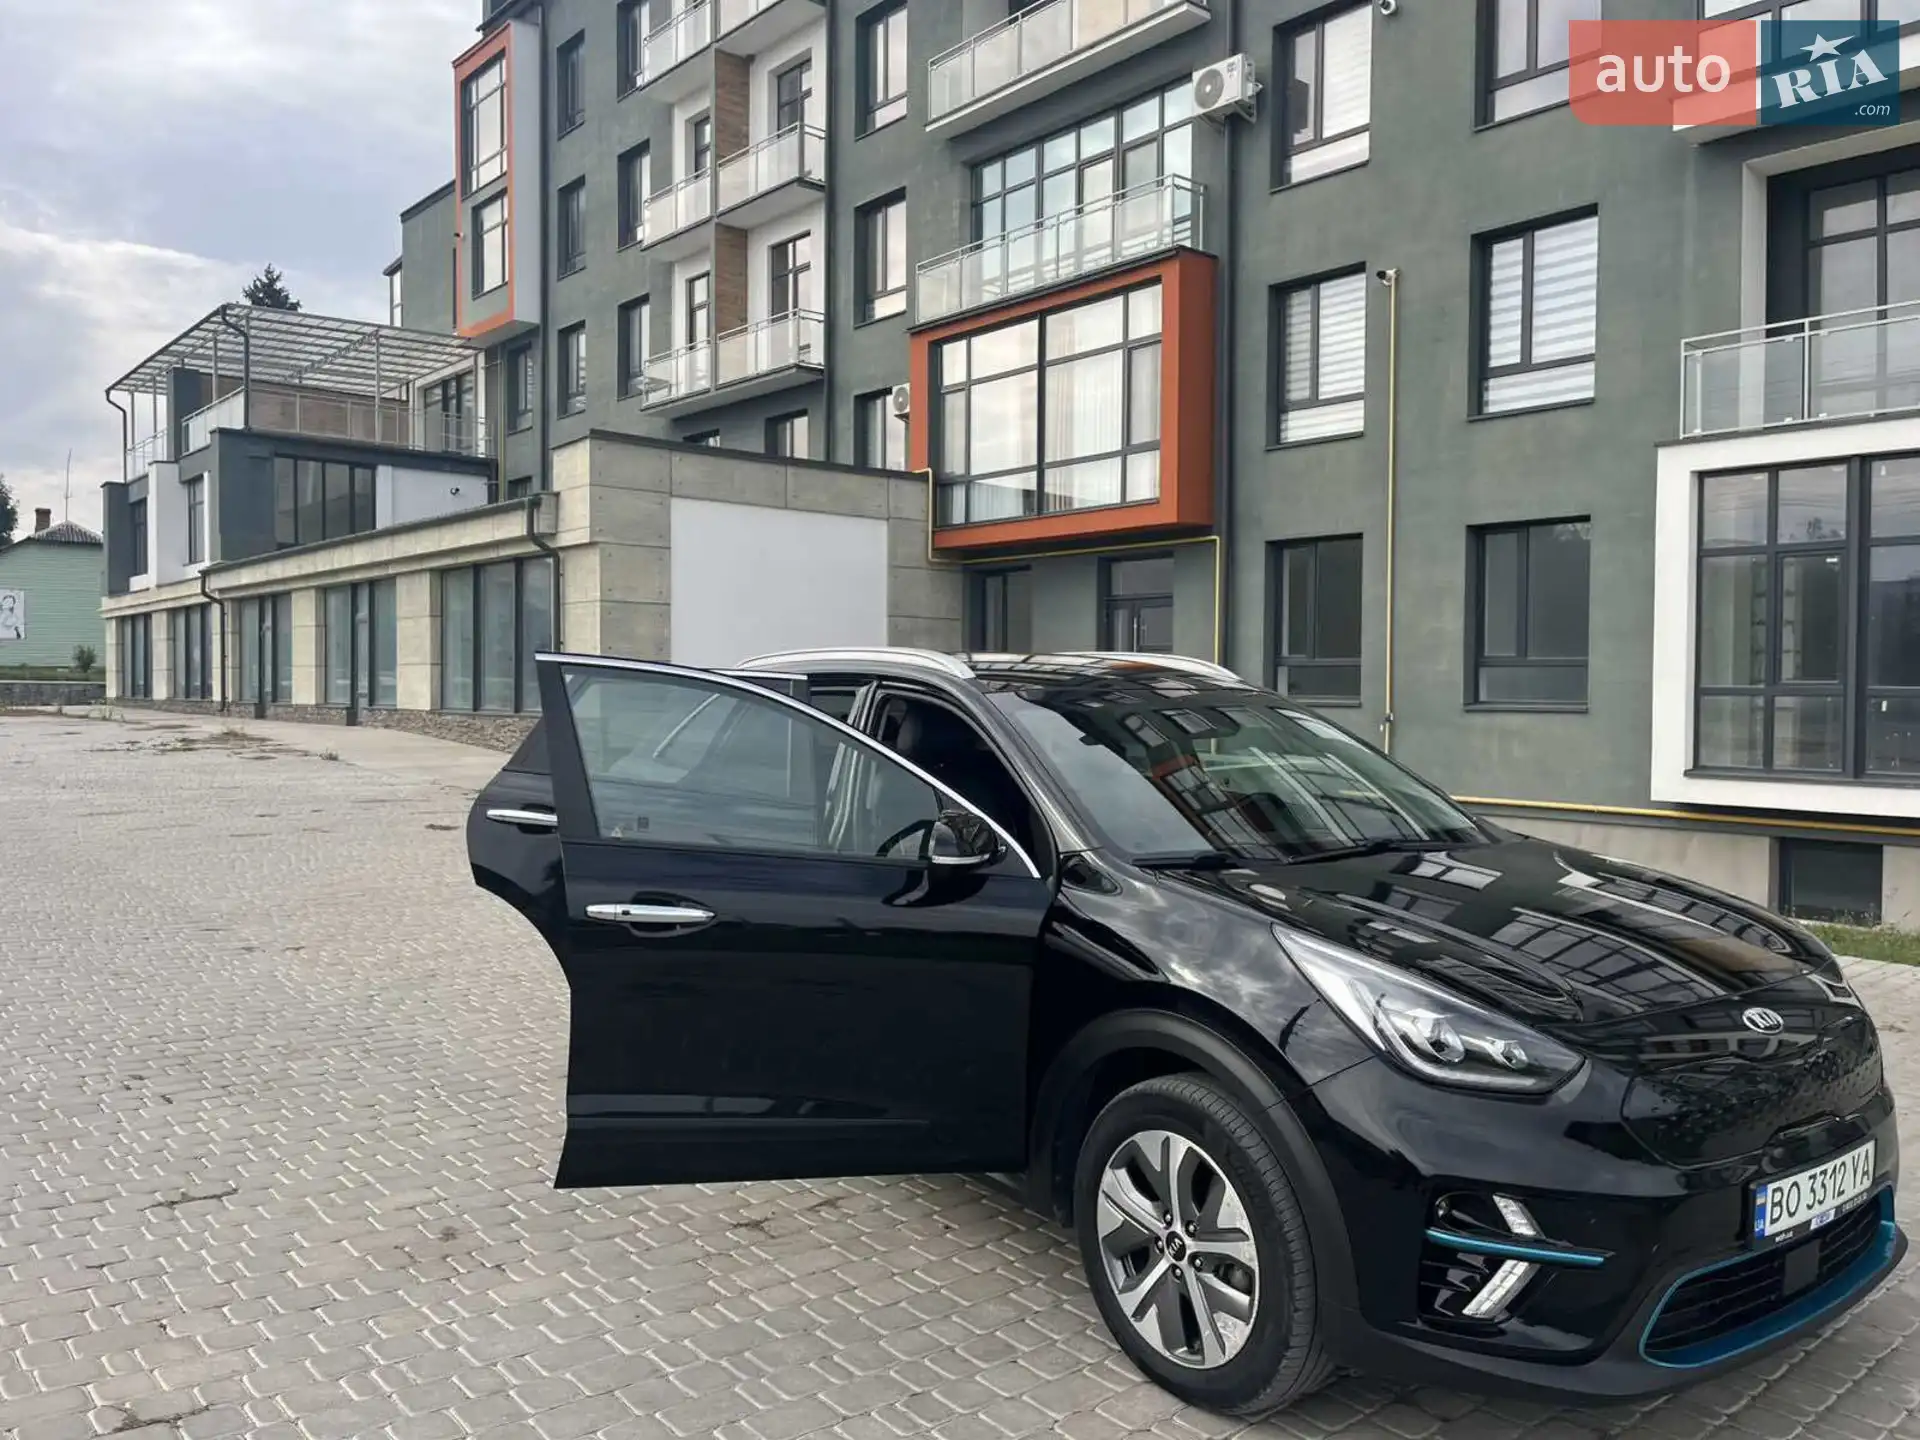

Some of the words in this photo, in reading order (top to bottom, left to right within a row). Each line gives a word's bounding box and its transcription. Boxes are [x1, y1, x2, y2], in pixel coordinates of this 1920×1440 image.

[1769, 1180, 1801, 1225] BO
[1805, 1161, 1847, 1211] 3312
[1851, 1148, 1870, 1189] YA
